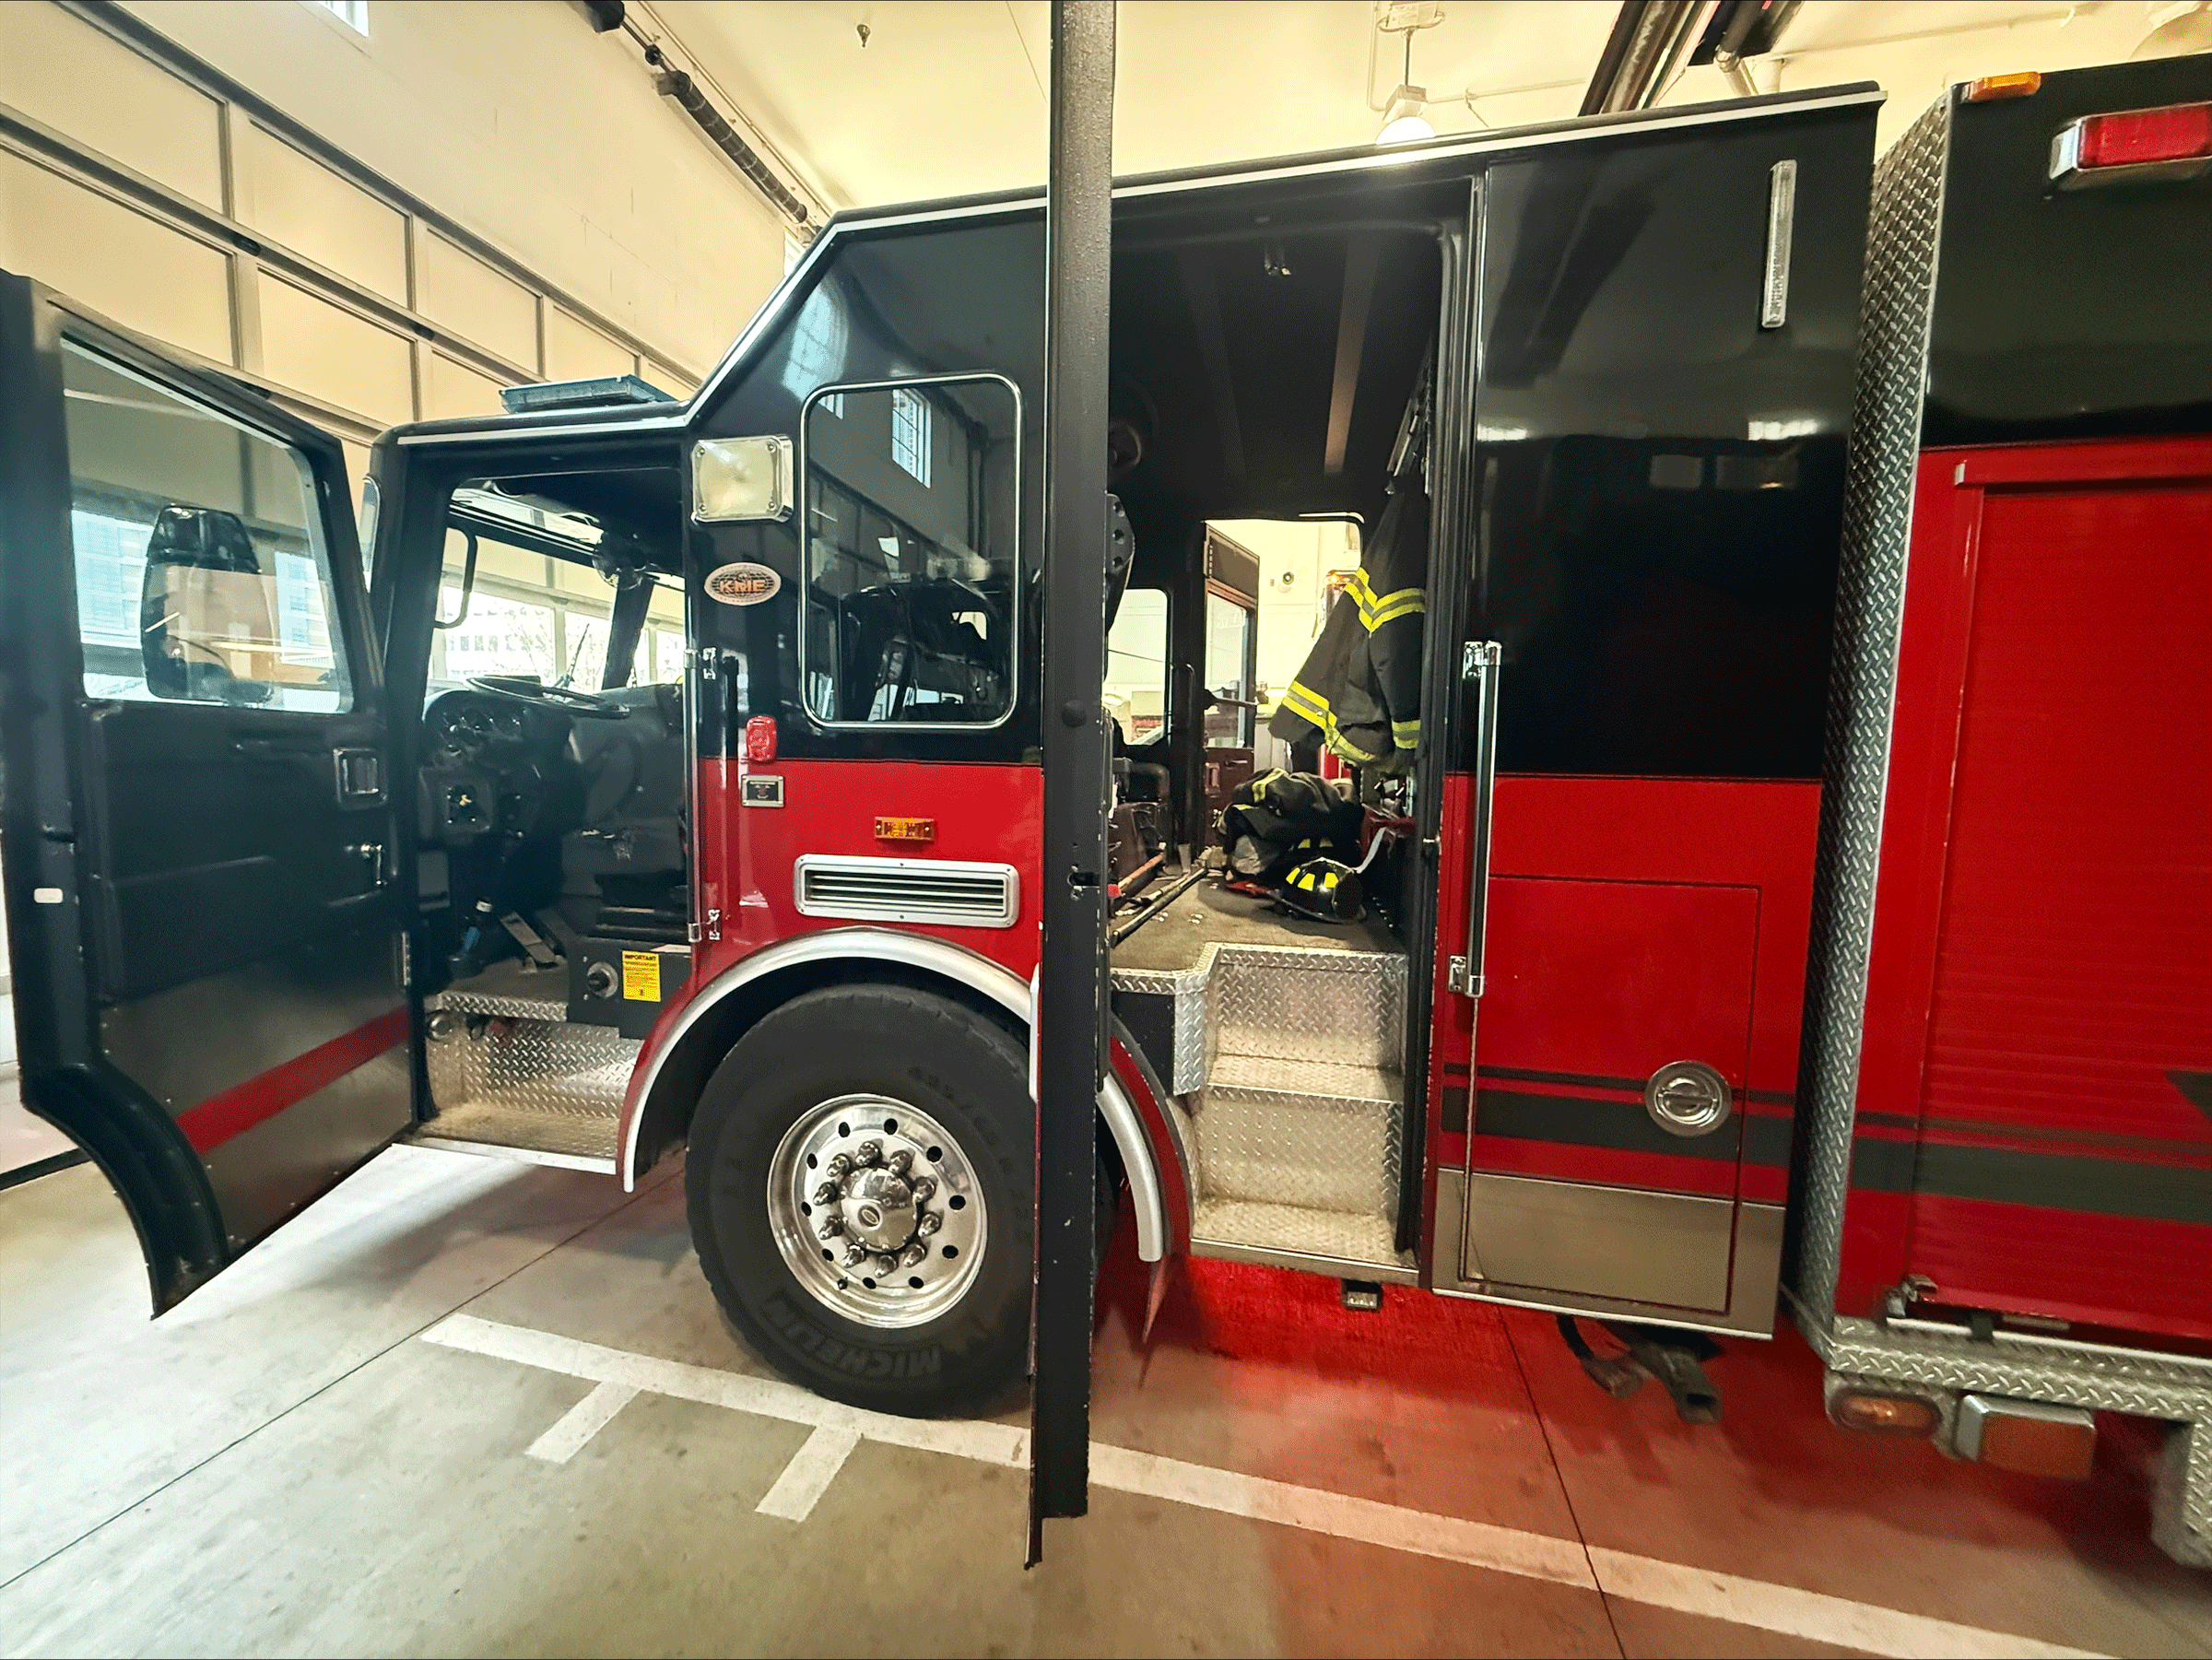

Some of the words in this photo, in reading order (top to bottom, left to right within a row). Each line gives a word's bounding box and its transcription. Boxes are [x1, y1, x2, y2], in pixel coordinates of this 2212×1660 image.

[719, 579, 766, 593] KME
[624, 953, 657, 961] IMPORTANT
[760, 1297, 941, 1379] MICHELIN
